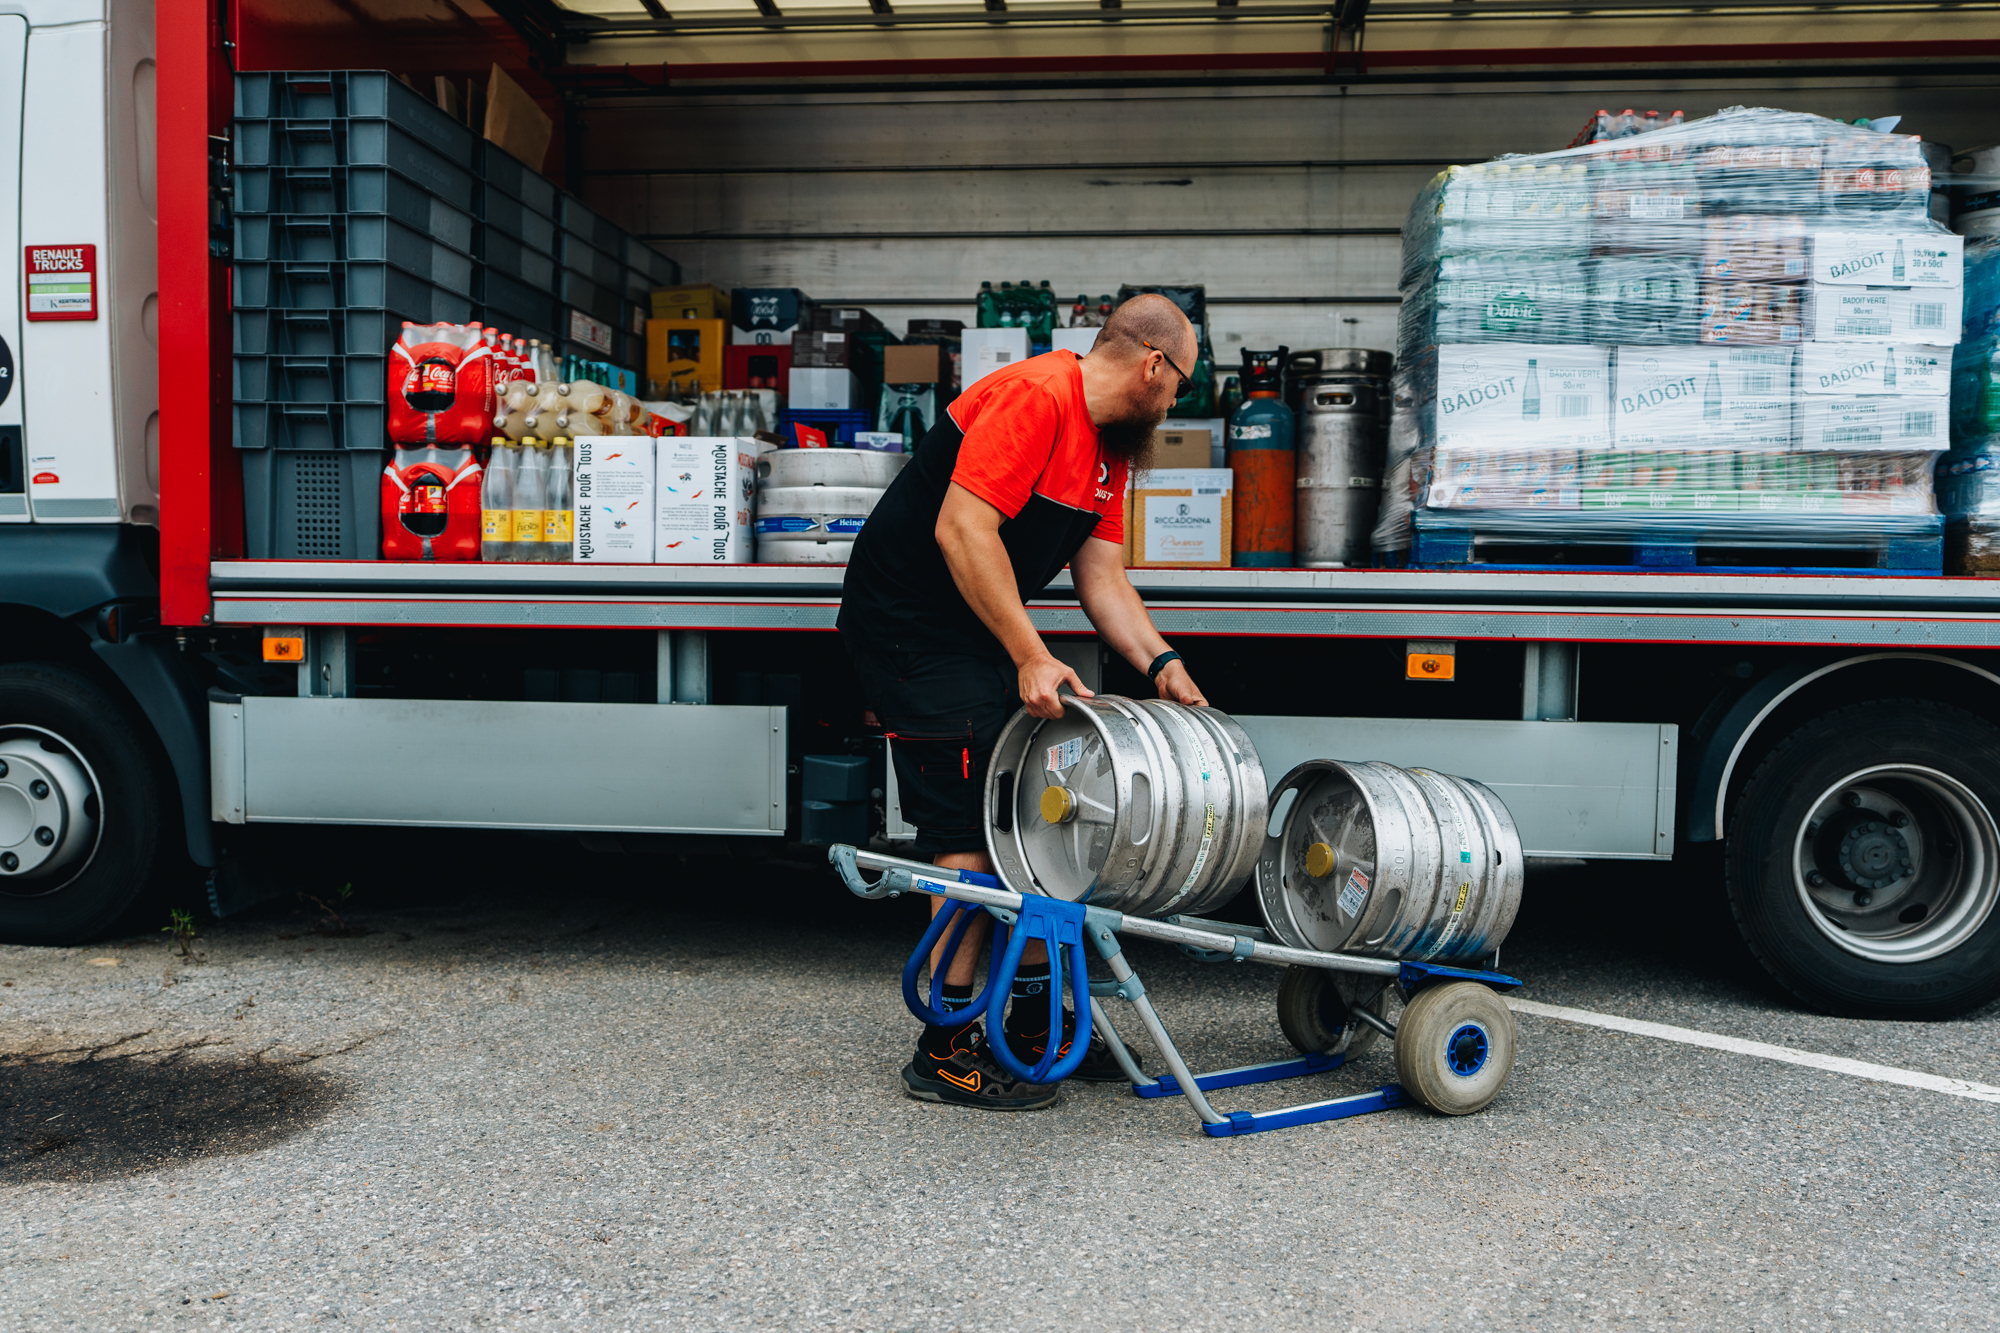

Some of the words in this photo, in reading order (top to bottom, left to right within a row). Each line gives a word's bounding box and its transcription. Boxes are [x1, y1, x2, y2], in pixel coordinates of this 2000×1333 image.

[33, 248, 83, 260] RENAULT
[33, 259, 84, 271] TRUCKS
[1830, 252, 1885, 279] BADOIT
[1549, 369, 1577, 378] BADOIT
[1578, 369, 1600, 379] VERTE
[1819, 360, 1875, 388] BADOIT
[1441, 376, 1516, 414] BADOIT
[1621, 376, 1697, 415] BADOIT
[576, 443, 592, 473] TOUS
[711, 444, 728, 499] MOUSTACHE
[576, 473, 592, 498] POUR
[1605, 492, 1628, 501] fuze
[1650, 492, 1673, 501] fuze
[1694, 492, 1717, 501] fuze
[713, 505, 730, 531] POUR
[1154, 516, 1212, 525] RICCADONNA
[579, 504, 594, 559] MOUSTACHE
[713, 531, 730, 561] TOUS
[1394, 844, 1405, 877] 30L
